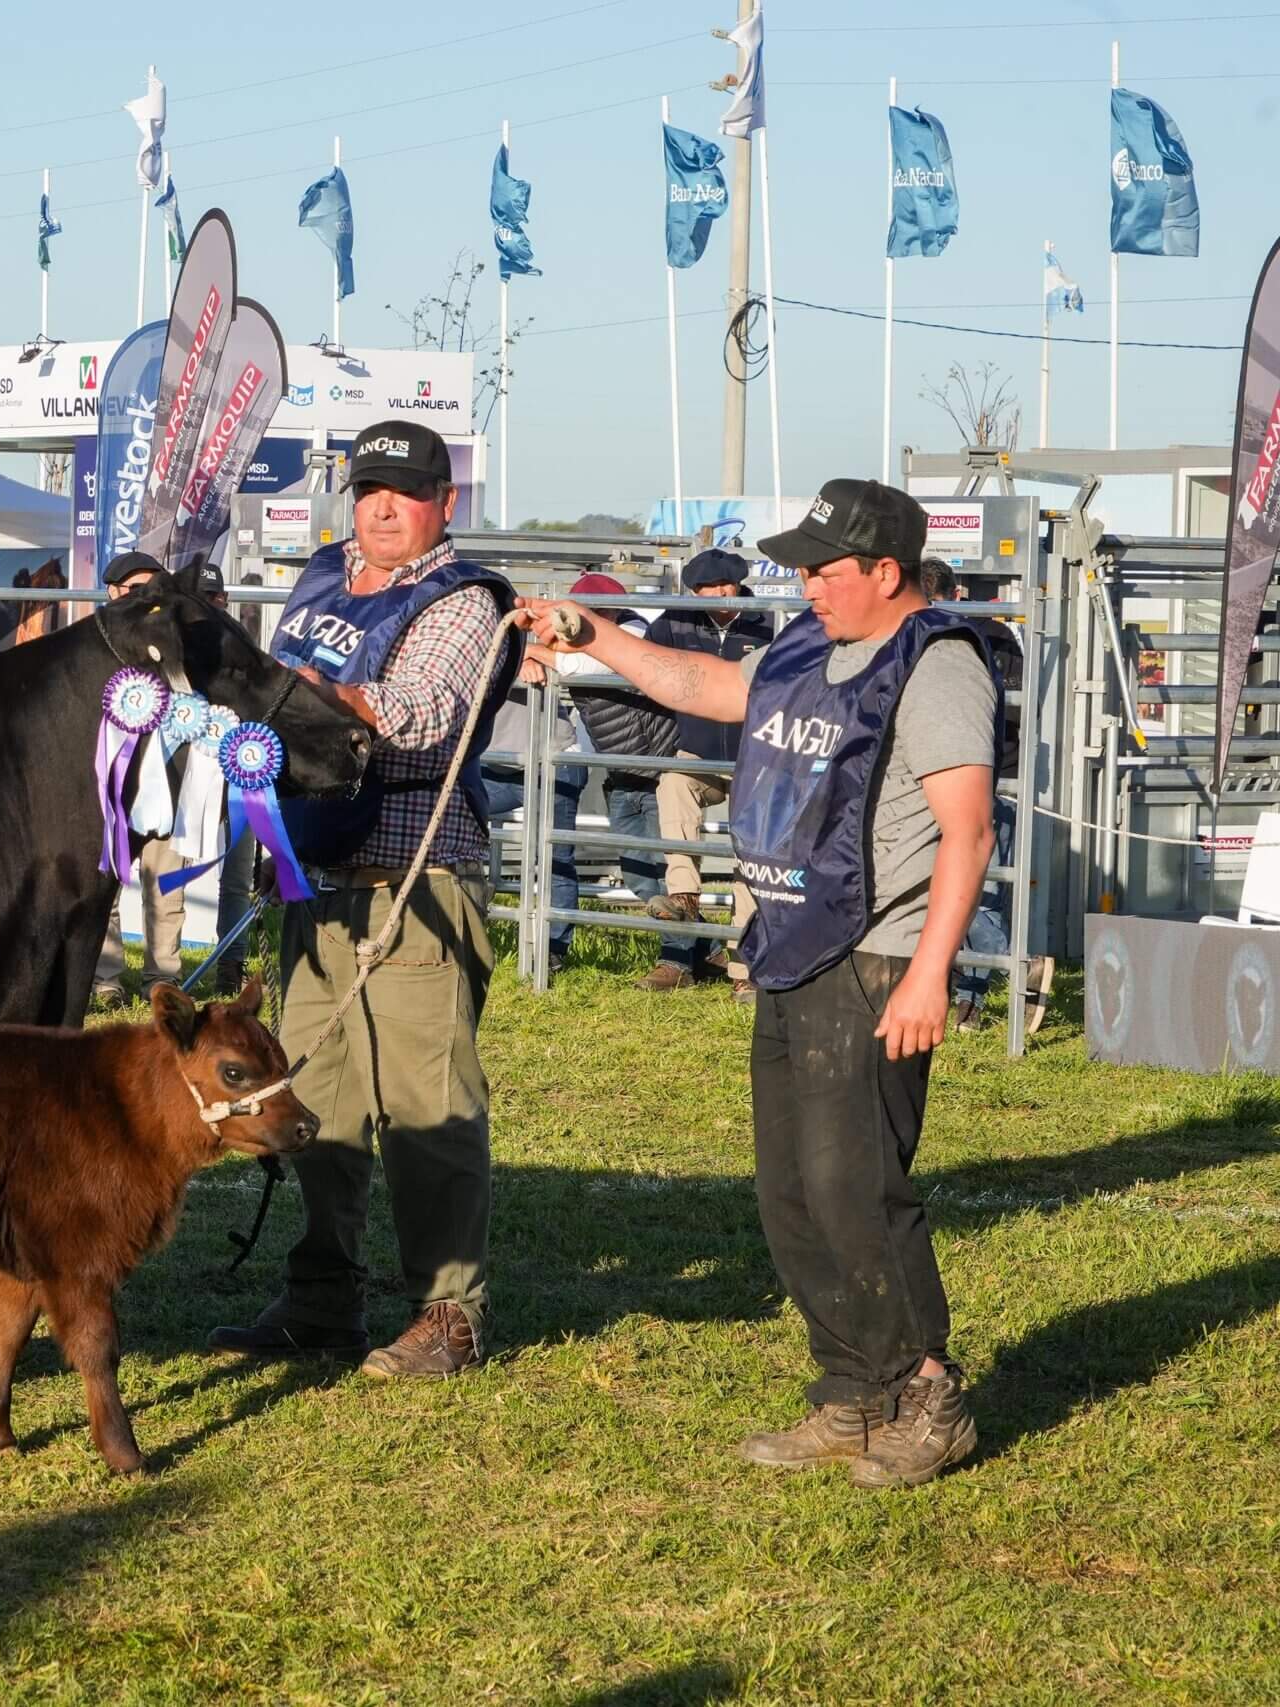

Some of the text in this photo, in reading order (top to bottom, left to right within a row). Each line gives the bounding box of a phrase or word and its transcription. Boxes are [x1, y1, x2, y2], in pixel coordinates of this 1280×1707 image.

[155, 291, 219, 477] FARMQUIP
[345, 389, 364, 399] MSD
[388, 398, 460, 411] VILLANUEVA
[184, 365, 258, 509] FARMQUIP
[356, 437, 410, 457] ANGUS
[114, 394, 158, 554] ivestock
[247, 463, 269, 474] MSD
[270, 511, 309, 522] FARMQUIP
[928, 516, 980, 528] FARMQUIP
[752, 710, 844, 758] ANGU
